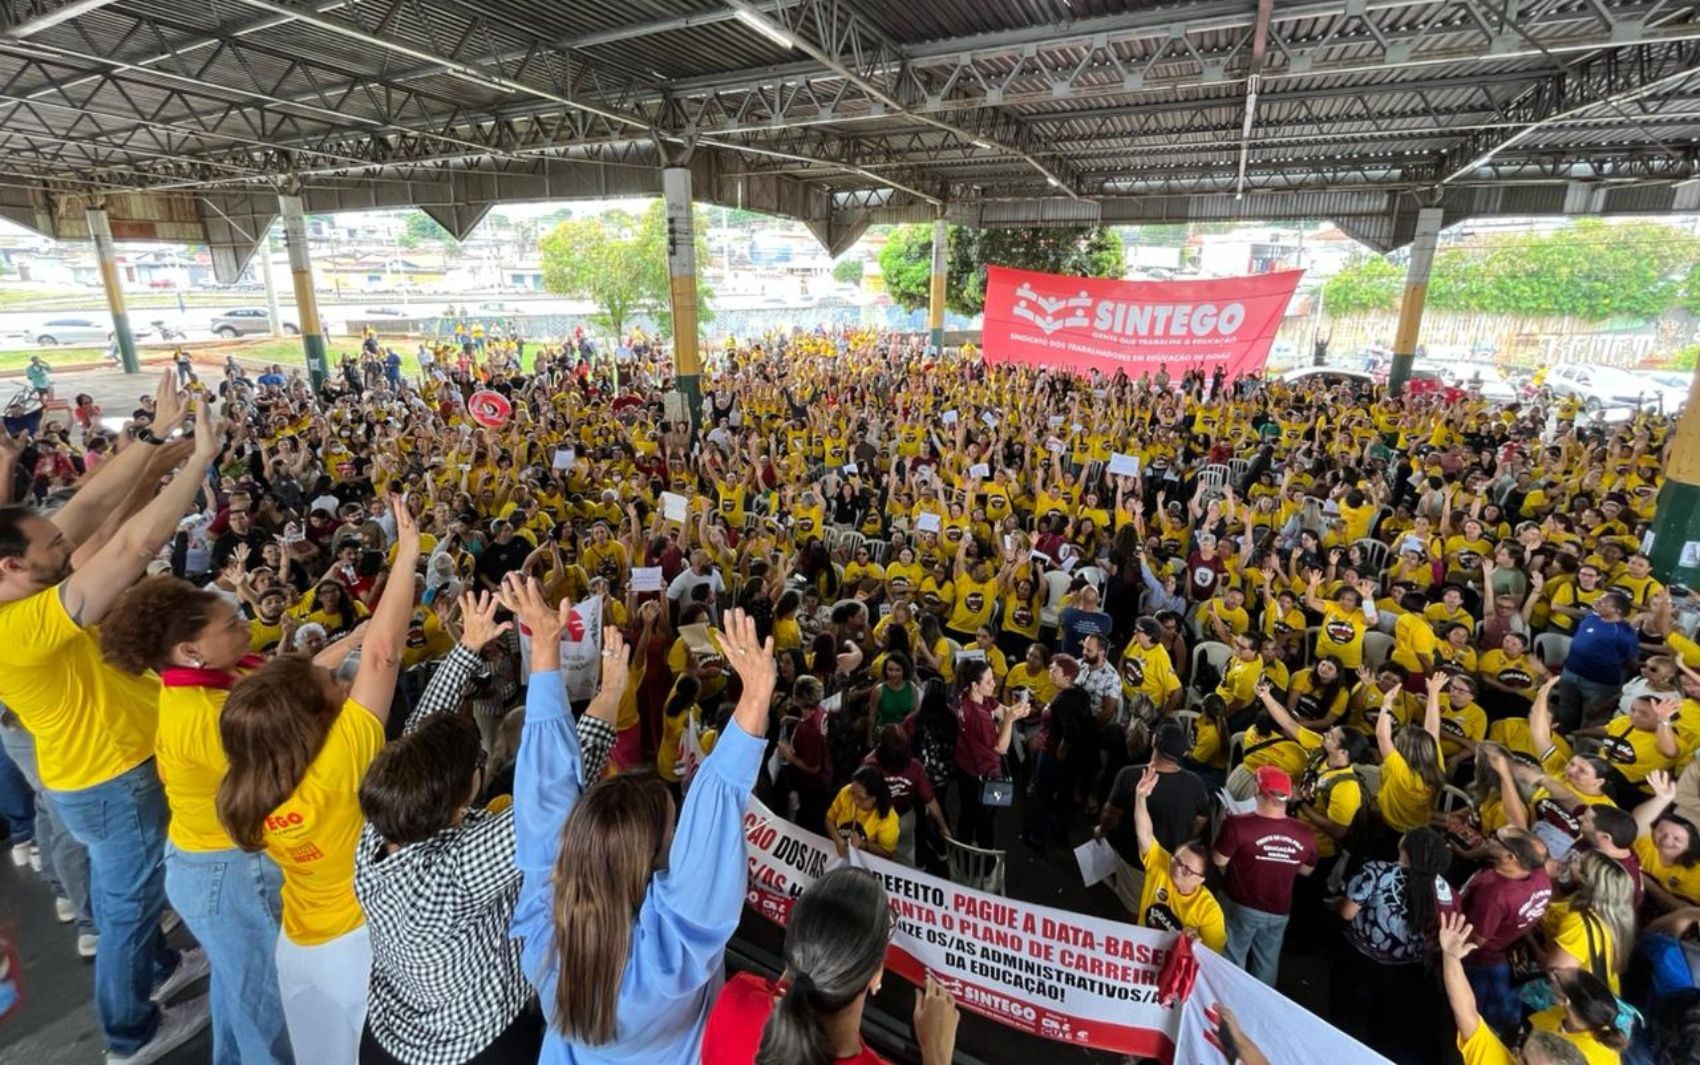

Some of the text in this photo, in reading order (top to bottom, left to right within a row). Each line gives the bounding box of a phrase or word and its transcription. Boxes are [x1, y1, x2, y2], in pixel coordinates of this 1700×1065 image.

[1093, 300, 1246, 337] SINTEGO
[1010, 332, 1048, 346] SINDICATO
[1067, 343, 1131, 362] TRABALHADORES
[1146, 351, 1192, 363] EDUCAÇÃO
[953, 893, 1018, 930] PAGUE
[1022, 912, 1037, 935] A
[888, 898, 1157, 986] ANTA O PLANO DE CARREIR
[926, 928, 976, 956] OS/AS
[980, 945, 1172, 1008] ADMINISTRATIVOS/A
[945, 953, 1066, 1004] DA EDUCAÇÃO!
[964, 987, 1037, 1022] SINTEGO
